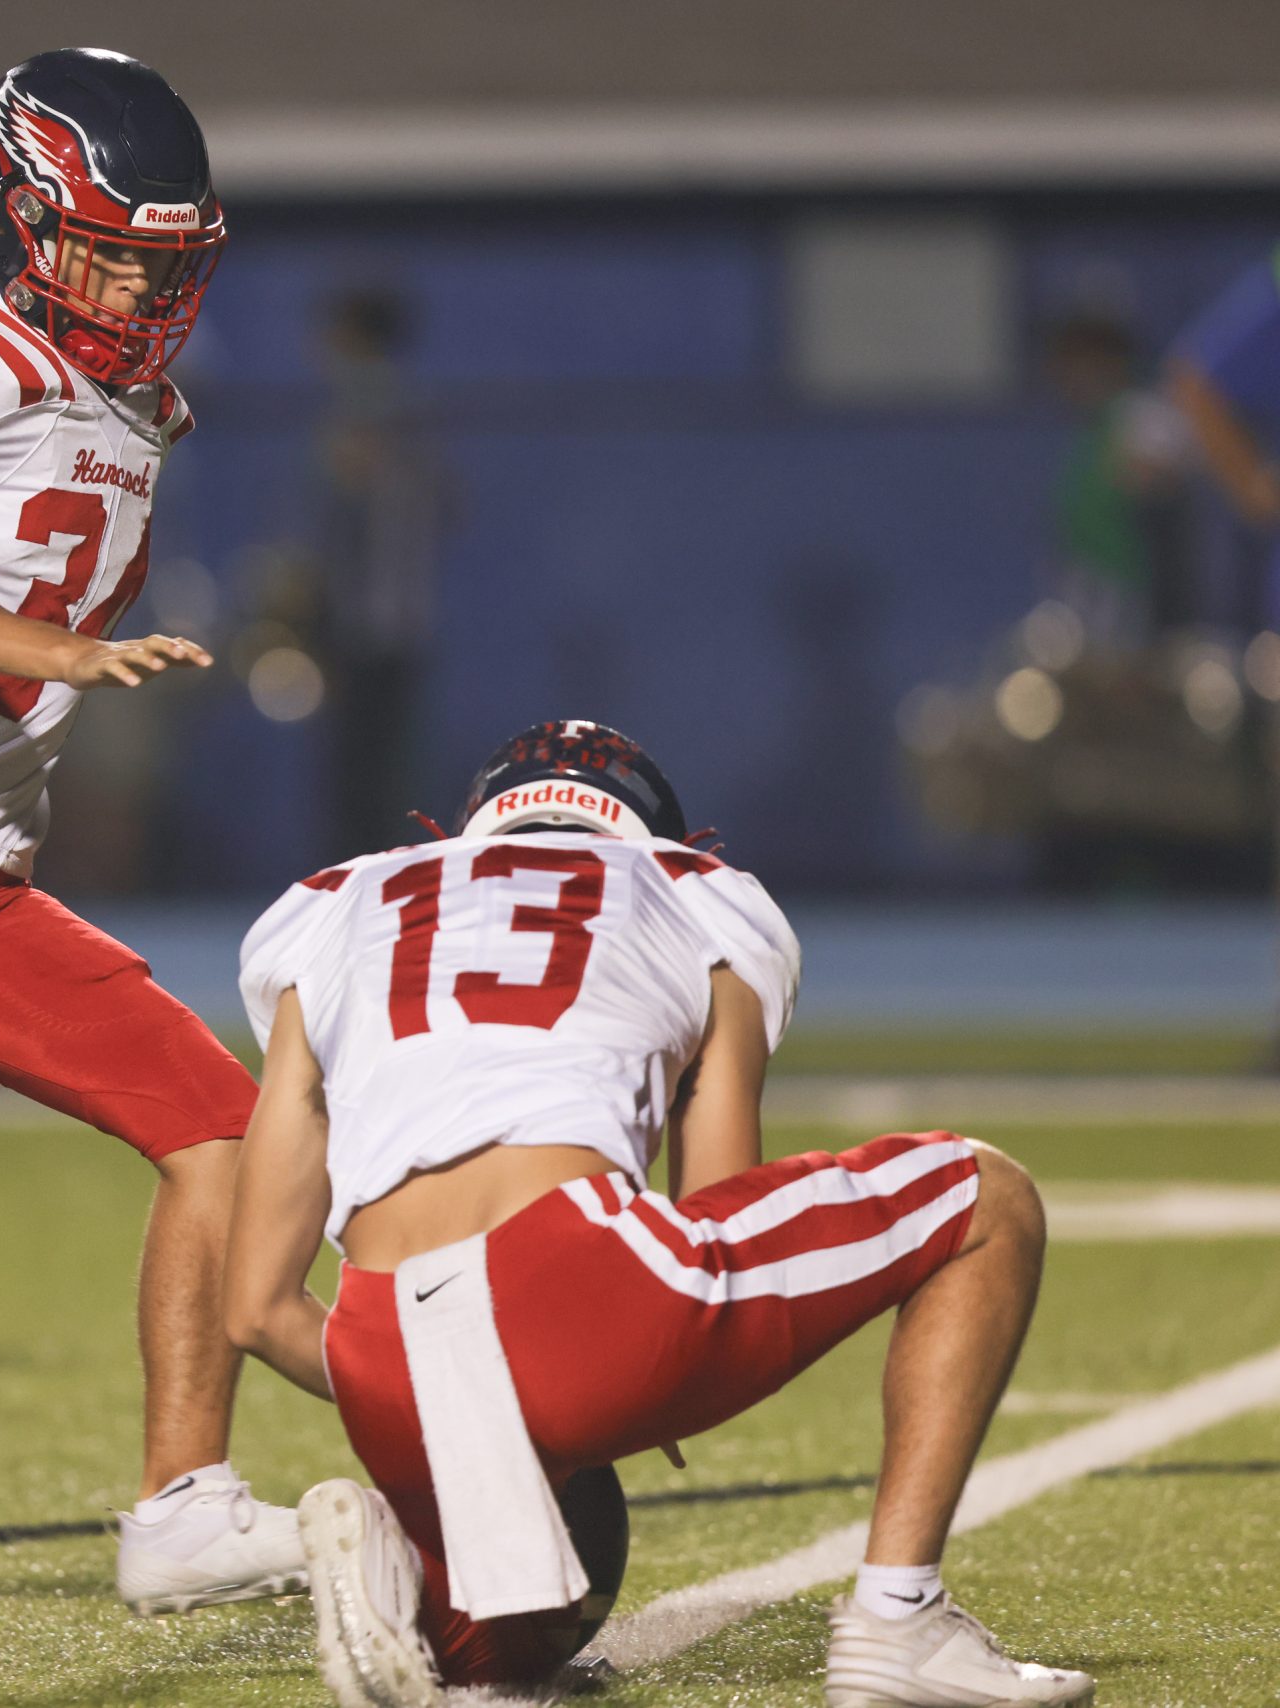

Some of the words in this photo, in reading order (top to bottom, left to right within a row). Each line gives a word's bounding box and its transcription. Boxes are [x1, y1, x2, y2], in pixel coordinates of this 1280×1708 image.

[146, 208, 195, 223] Riddell
[32, 240, 53, 278] idde
[71, 449, 150, 499] Hancock
[495, 784, 621, 823] Riddell
[382, 844, 606, 1041] 13
